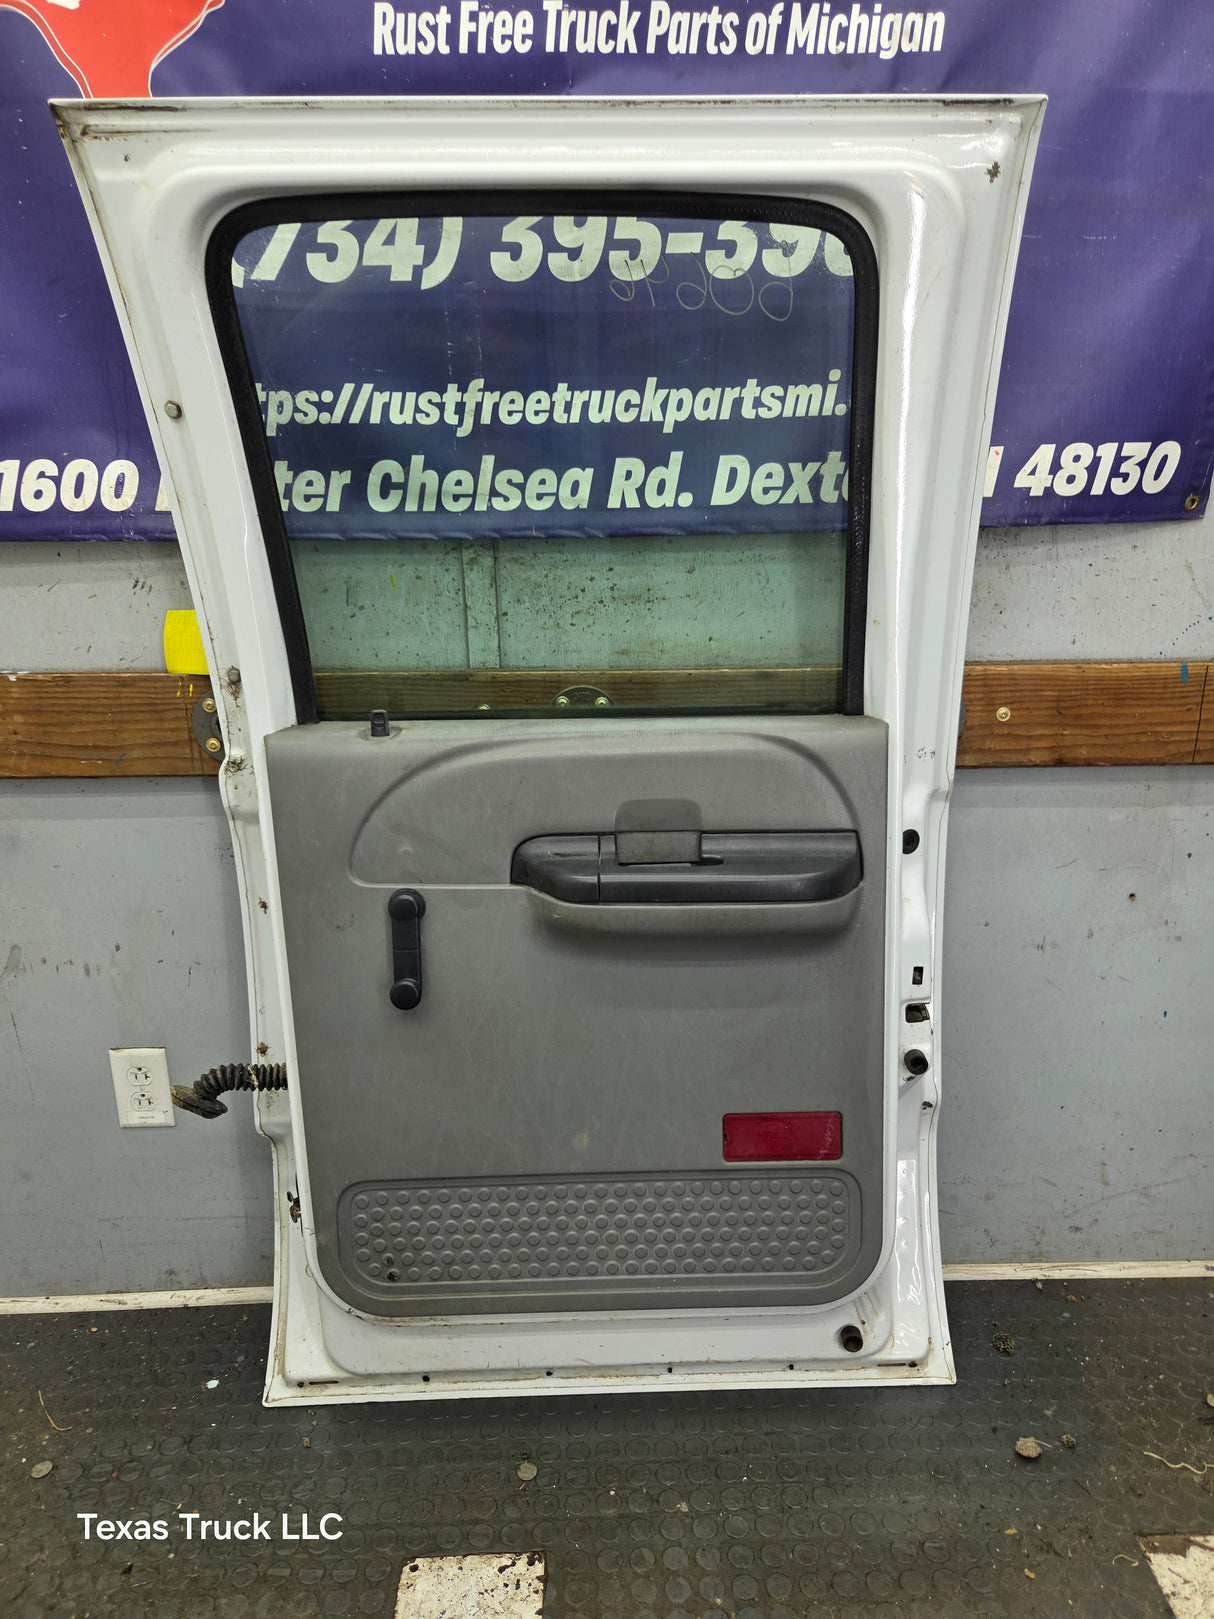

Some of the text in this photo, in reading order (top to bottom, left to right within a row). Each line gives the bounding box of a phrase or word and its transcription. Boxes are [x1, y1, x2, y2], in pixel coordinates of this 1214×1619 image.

[373, 0, 946, 59] Rust Free Truck Parts of Michigan
[0, 459, 140, 511] 1600
[368, 455, 594, 512] Chelsea
[607, 451, 694, 508] Rd.
[711, 452, 849, 506] Dext
[1014, 440, 1182, 497] 48130
